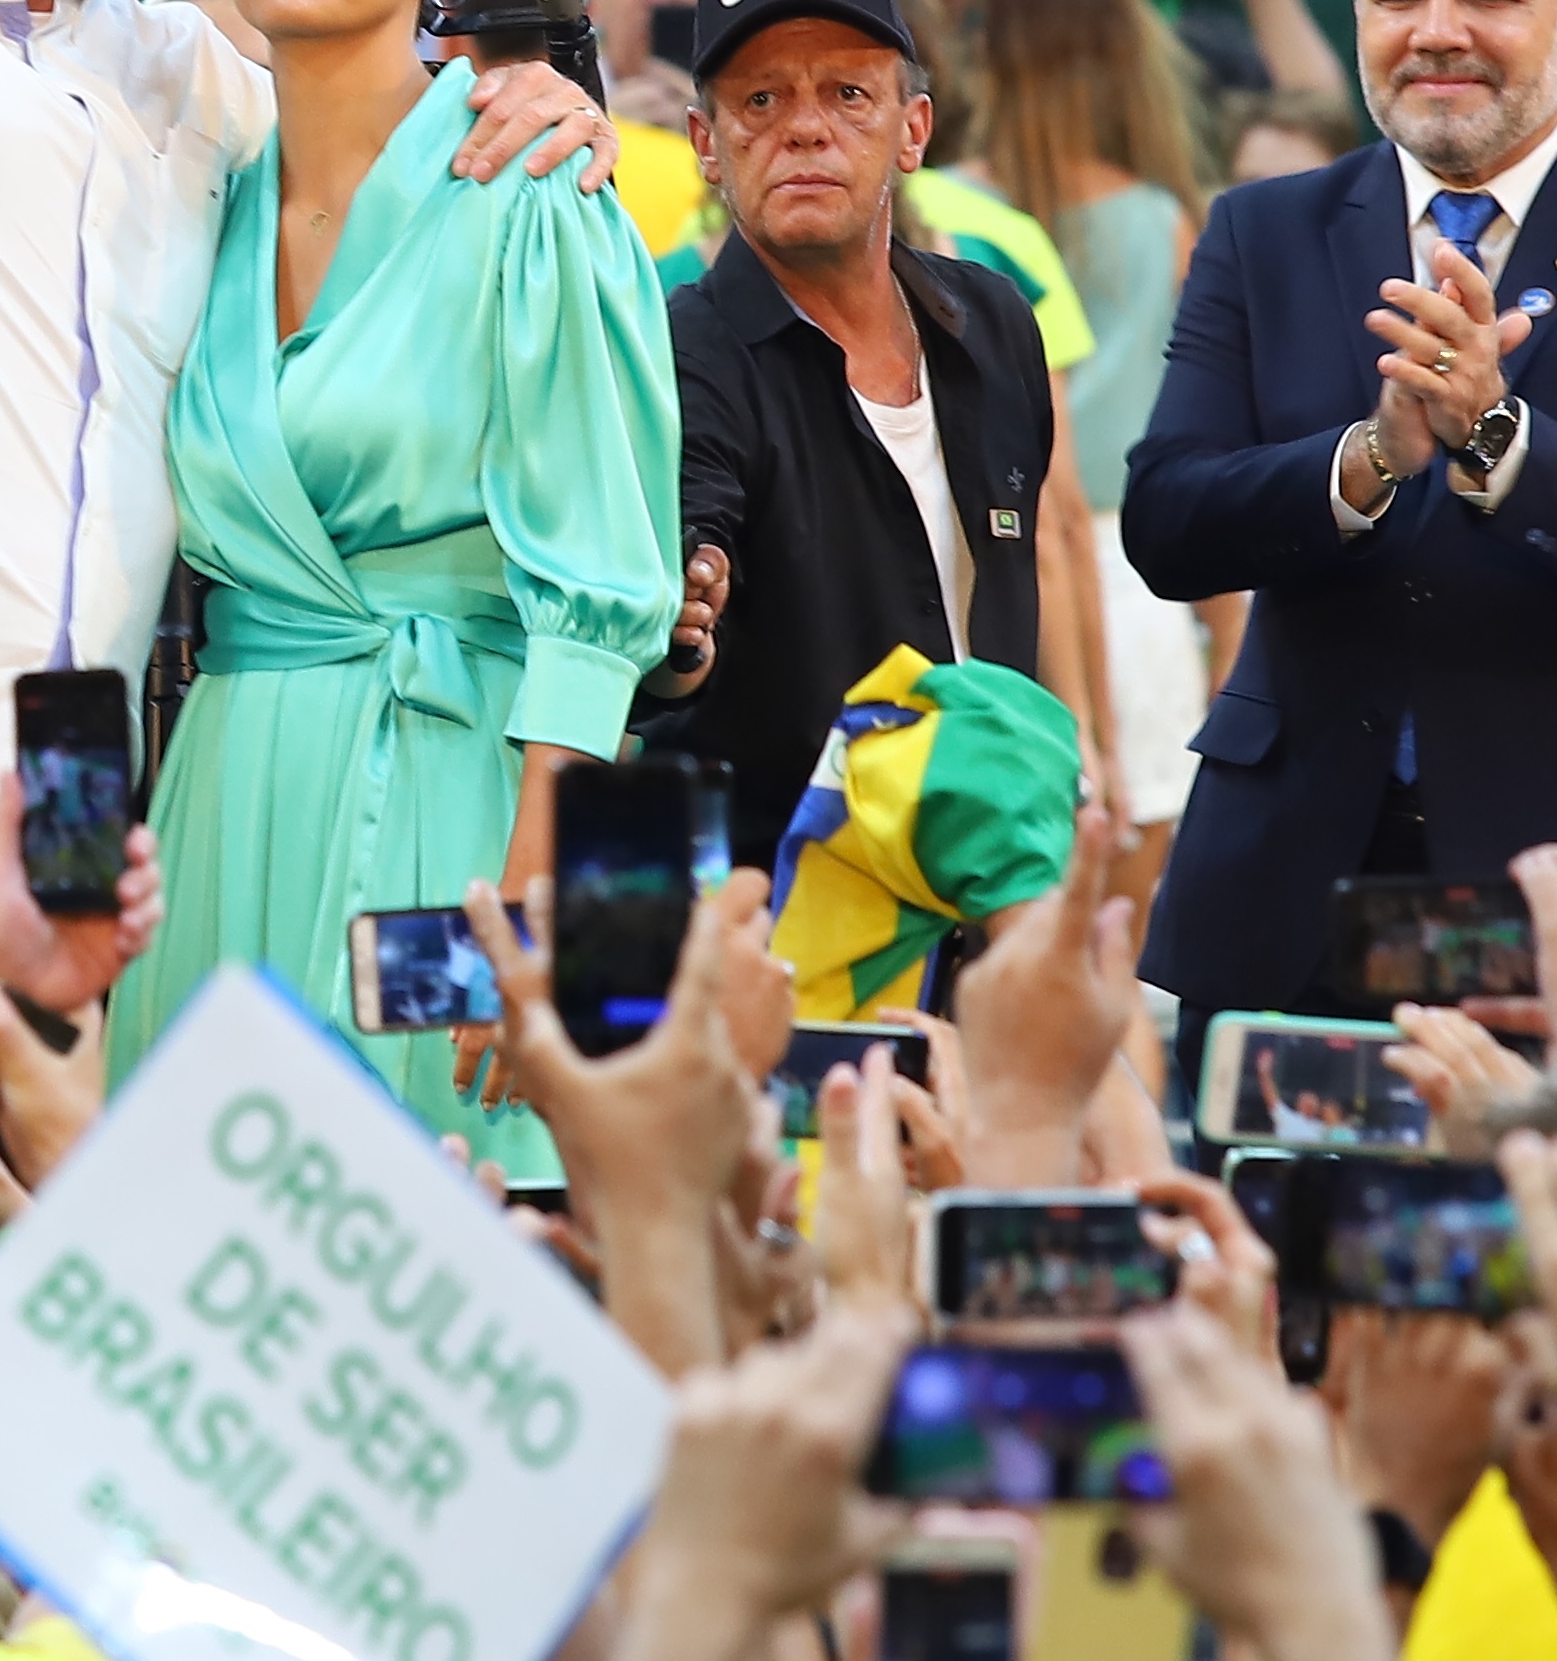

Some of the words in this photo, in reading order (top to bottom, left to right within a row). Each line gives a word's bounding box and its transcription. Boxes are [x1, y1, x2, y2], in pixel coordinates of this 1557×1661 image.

[17, 1248, 476, 1661] BRASILEIRO
[182, 1233, 324, 1380] DE
[302, 1346, 471, 1528] SER
[208, 1088, 583, 1472] ORGULHO
